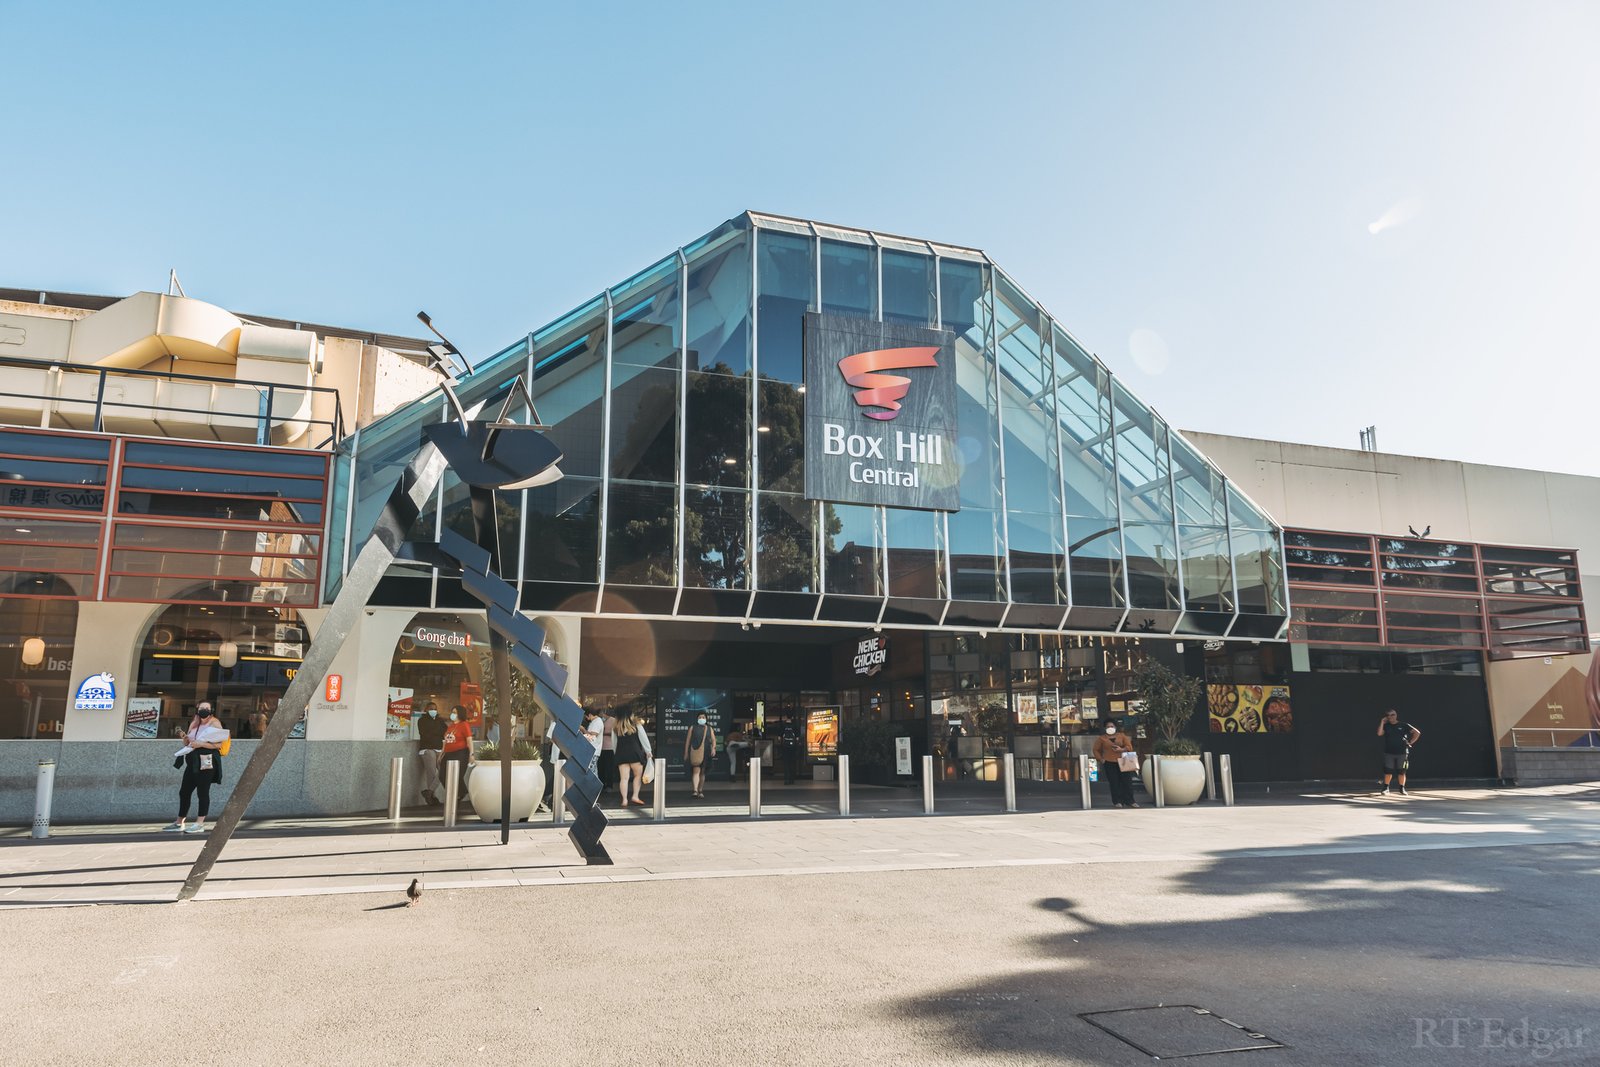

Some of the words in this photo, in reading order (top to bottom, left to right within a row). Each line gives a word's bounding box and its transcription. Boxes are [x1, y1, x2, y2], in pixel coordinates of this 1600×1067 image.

[823, 423, 884, 460] Box
[895, 430, 942, 465] Hill
[850, 461, 919, 488] Central
[417, 627, 446, 647] Gong
[447, 632, 465, 646] cha
[858, 637, 879, 654] NENE
[1203, 641, 1224, 649] CHICKEN
[853, 649, 886, 668] CHICKEN
[317, 703, 335, 711] Gong
